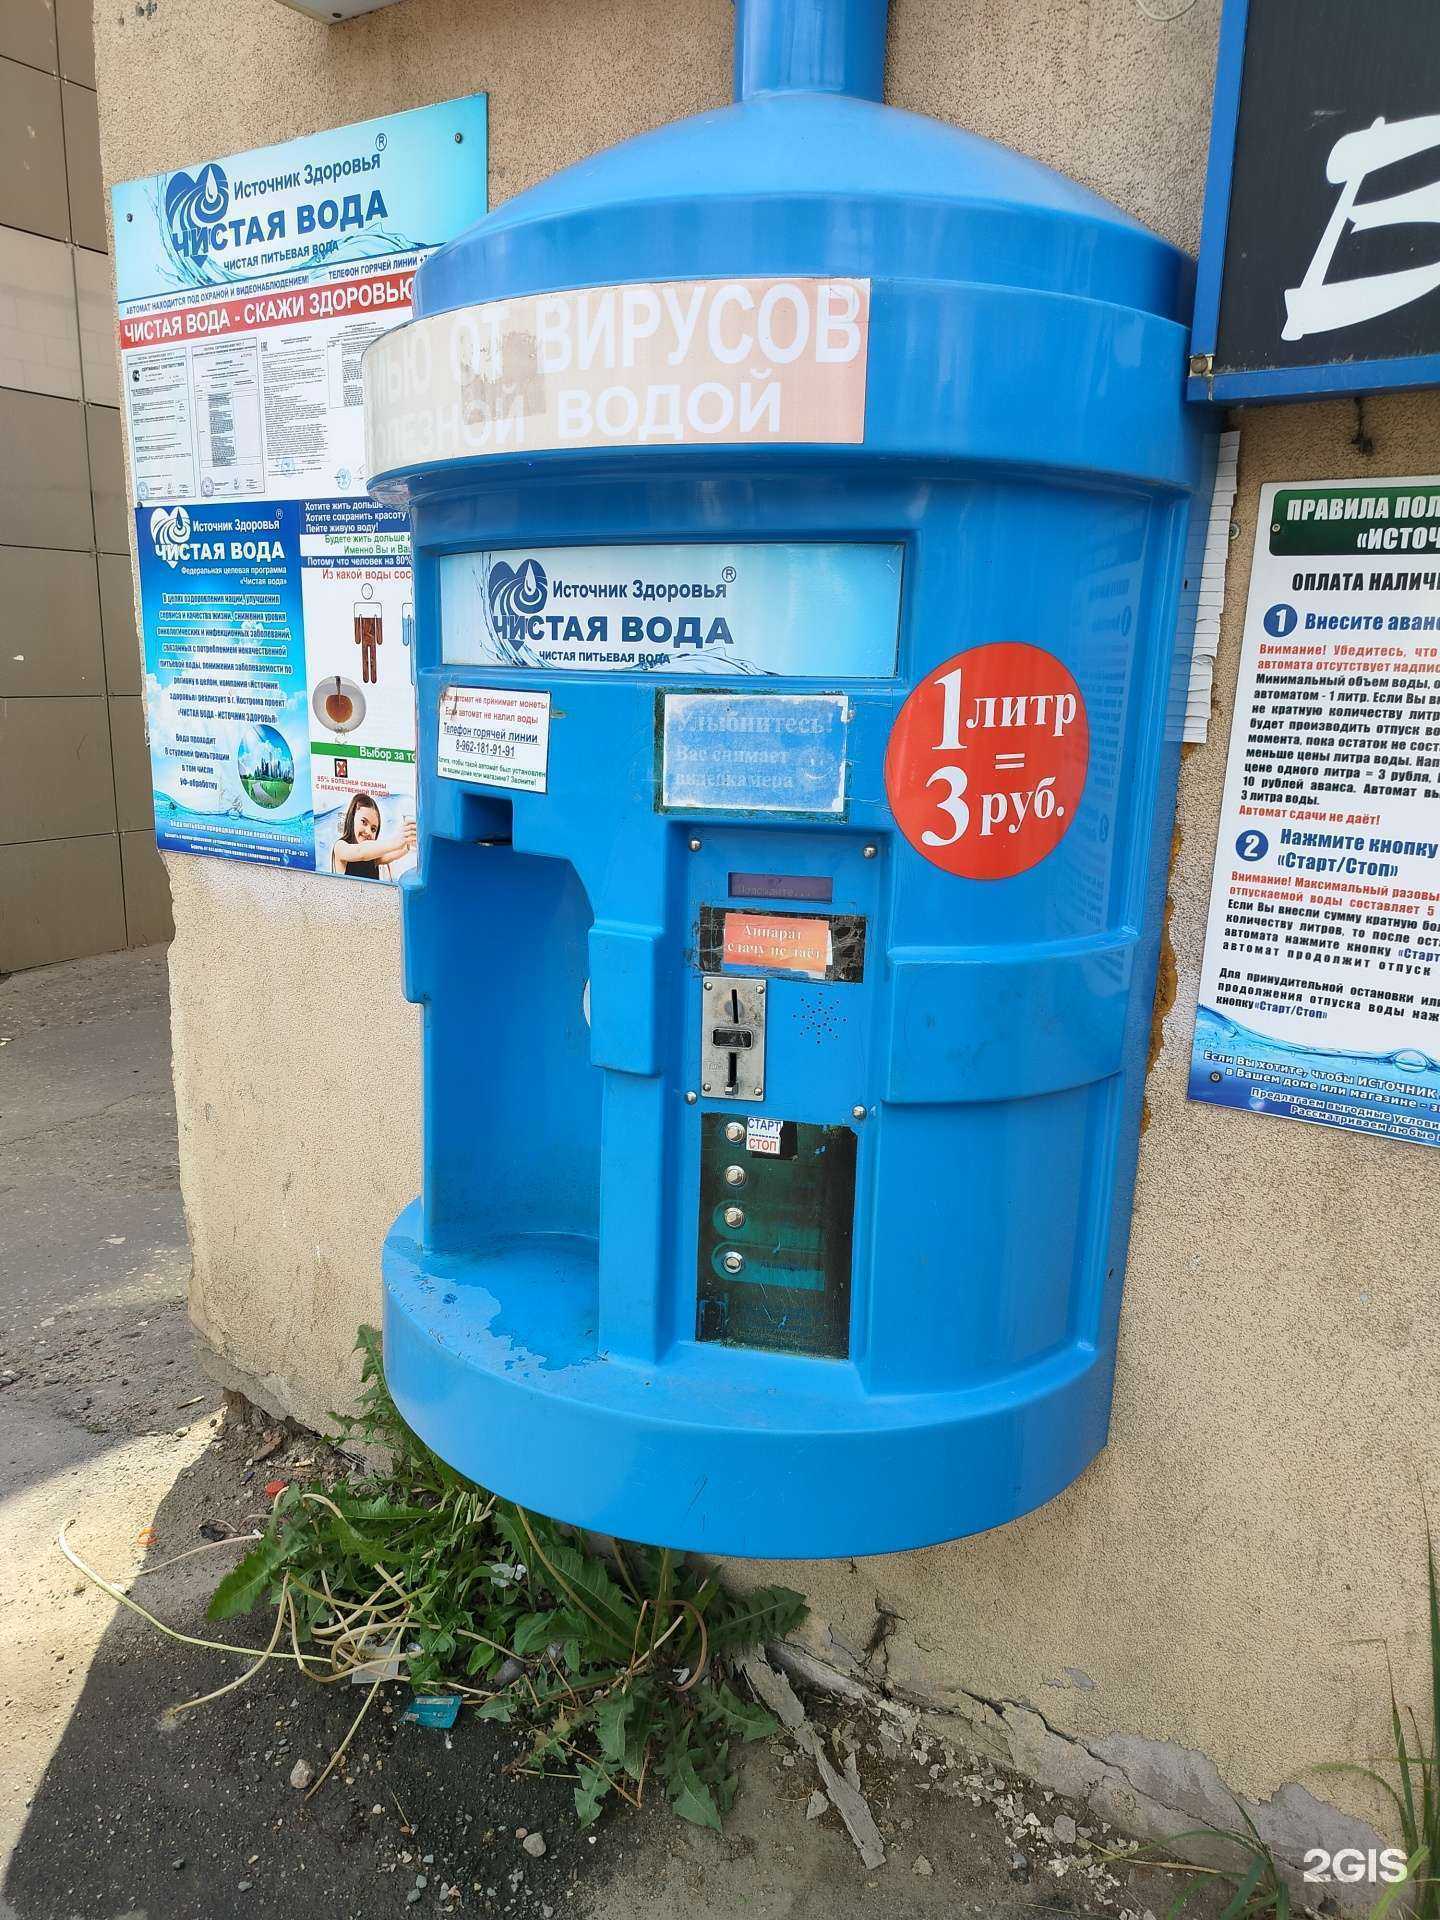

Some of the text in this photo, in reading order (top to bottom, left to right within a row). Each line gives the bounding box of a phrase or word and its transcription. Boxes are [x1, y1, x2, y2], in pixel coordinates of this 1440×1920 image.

[234, 153, 381, 201] Источник Здоровья
[172, 189, 388, 259] ЧИСТАЯ ВОДА
[223, 240, 339, 272] ЧИСТАЯ ПИТЬЕВАЯ ВОДА
[328, 256, 417, 280] ТЕЛЕФОН ГОРЯЧЕЙ ЛИНИИ
[126, 303, 151, 314] АВТОМАТ
[152, 297, 186, 310] НАХОДИТСЯ
[187, 295, 200, 304] ПОД
[200, 287, 228, 300] ОХРАНОЙ
[124, 316, 182, 342] ЧИСТАЯ
[186, 309, 230, 334] ВОДА
[244, 296, 304, 324] СКАЖИ
[536, 283, 860, 374] ВИРУСОВ
[558, 368, 780, 439] ВОДОЙ
[305, 502, 330, 511] Хотите
[352, 502, 382, 511] дольше
[1287, 497, 1388, 520] ПРАВИЛА
[193, 519, 280, 533] Источник Здоровья
[306, 512, 406, 522] Хотите сохранить красоту
[306, 522, 378, 534] Пейте живую воду!
[325, 536, 351, 544] Будете
[374, 534, 404, 544] дольше
[155, 541, 285, 562] ЧИСТАЯ ВОДА
[344, 545, 388, 554] Именно Вы
[251, 566, 287, 576] программа
[308, 557, 335, 567] Потому
[352, 558, 382, 566] человек
[322, 569, 391, 580] Из какой воды
[1292, 572, 1364, 591] ОПЛАТА
[552, 579, 727, 602] Источник Здоровья
[1276, 609, 1383, 632] 1 Внесите
[494, 615, 734, 648] ЧИСТАЯ ВОДА
[538, 650, 670, 664] ЧИСТАЯ ПИТЬЕВАЯ ВОДА
[1260, 644, 1437, 658] Внимание! Убедитесь, что
[1257, 660, 1390, 673] автомата отсутствует
[1256, 674, 1430, 690] Минимальный объем воды,
[520, 700, 547, 708] монеты
[1254, 690, 1402, 704] автоматом Если
[459, 710, 538, 725] автомат налил воды
[932, 668, 1076, 750] 1 литр
[1272, 705, 1402, 720] кратную количеству
[444, 722, 538, 743] Телефон горячей линии
[1250, 718, 1420, 737] будет производить отпуск
[456, 739, 515, 757] 8-962-181-91-91
[1248, 734, 1387, 750] момента, остаток
[359, 746, 404, 761] Выбор за
[1246, 748, 1370, 764] меньше литра
[1391, 769, 1431, 783] рубля.
[922, 766, 1065, 846] 3 руб.
[1239, 805, 1381, 826] Автомат сдачи даёт!
[1244, 828, 1438, 858] 2 Нажмите кнопку
[1277, 852, 1399, 878] «Старт/Стоп»
[1231, 870, 1388, 896] Внимание! Максимальный
[1229, 886, 1420, 916] отпускаемой составляет
[1285, 934, 1340, 950] нажмите
[1287, 950, 1371, 968] продолжит
[1246, 971, 1414, 1004] принудительной остановки
[1236, 1068, 1417, 1108] Вашем магазине
[1258, 1060, 1436, 1099] хотите, чтобы ИСТОЧНИК
[1251, 1088, 1391, 1120] Предлагаем выгодные
[748, 1118, 782, 1132] СТАРТ
[1290, 1105, 1434, 1142] Рассматриваем любые
[749, 1137, 778, 1152] СТОП
